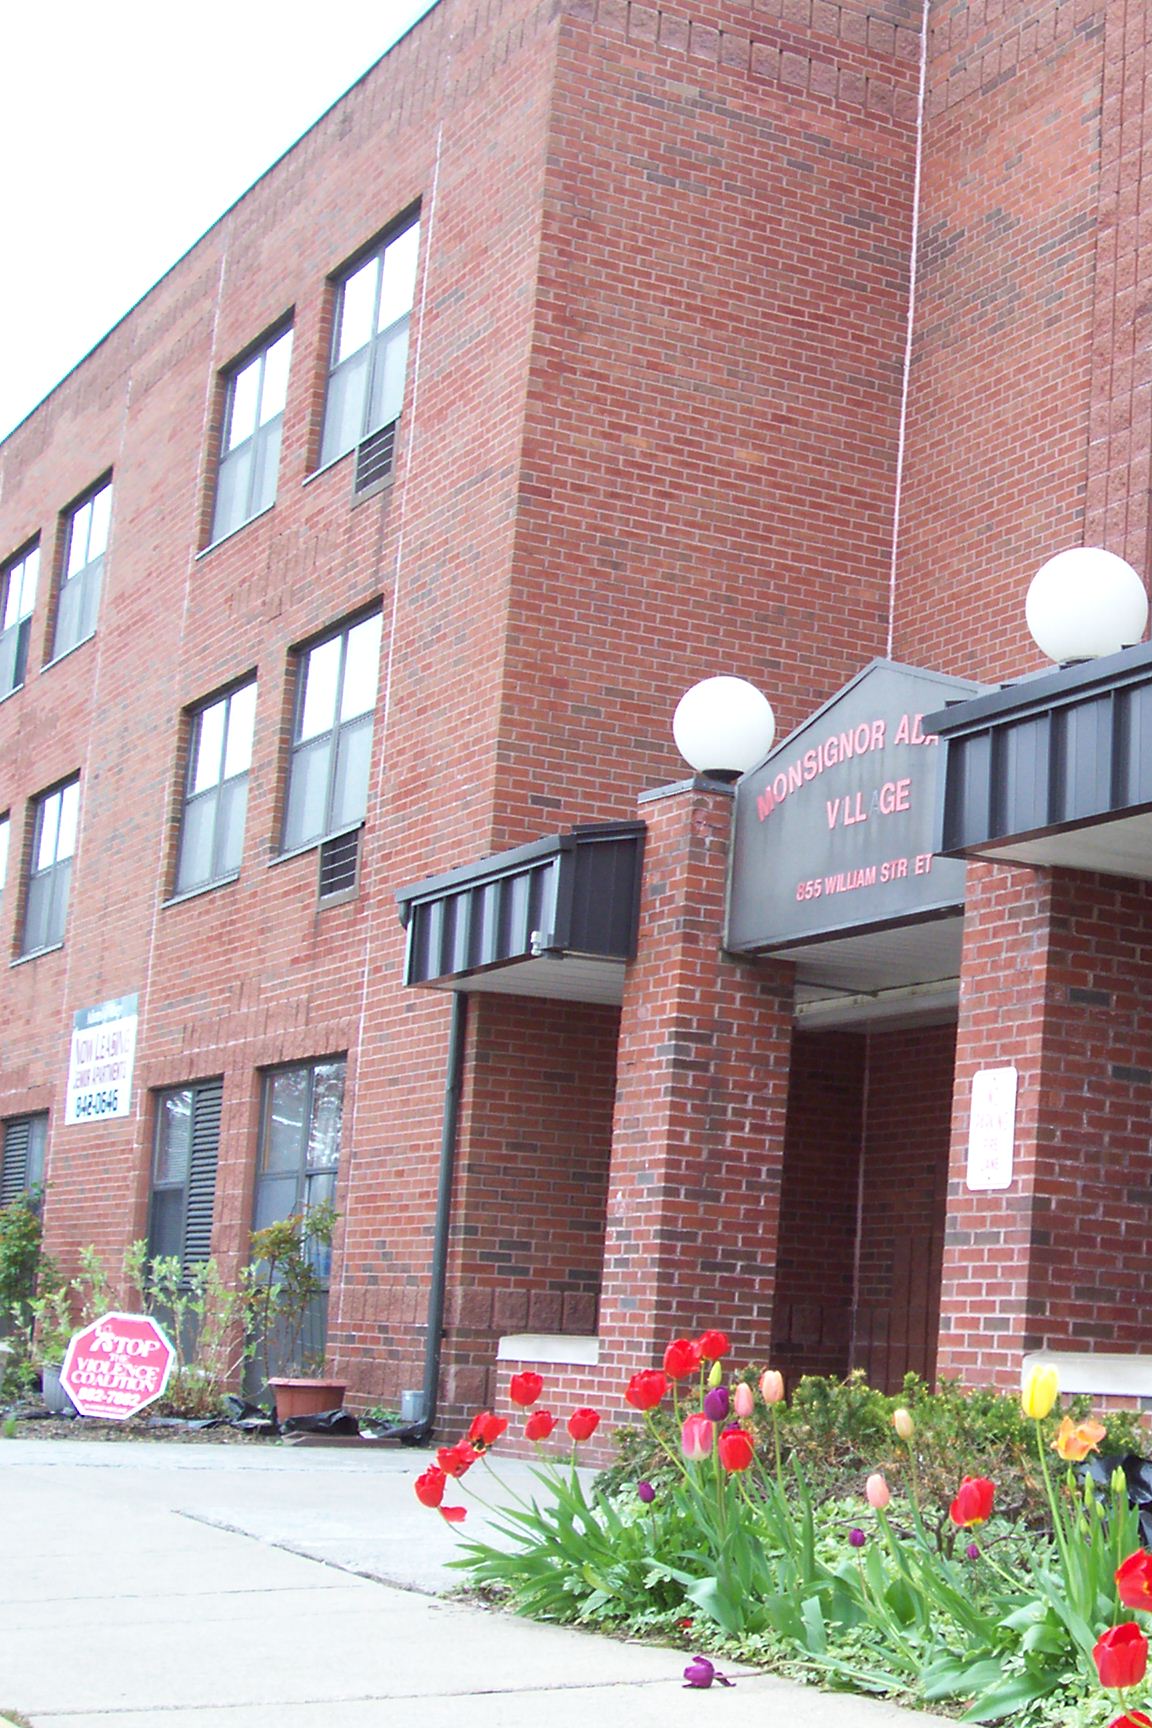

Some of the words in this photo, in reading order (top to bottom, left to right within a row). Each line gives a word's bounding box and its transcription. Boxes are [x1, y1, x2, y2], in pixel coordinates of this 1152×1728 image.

[756, 719, 887, 822] MONSIGNOR
[826, 778, 912, 830] VLLAGE
[796, 879, 822, 901] 855
[825, 866, 876, 895] WILLIAM
[880, 853, 933, 883] STRET
[76, 1038, 93, 1065] NOW
[101, 1332, 160, 1357] STOP
[77, 1357, 159, 1380] VIOLENCE
[109, 1353, 131, 1364] THE
[71, 1370, 155, 1392] COALITION
